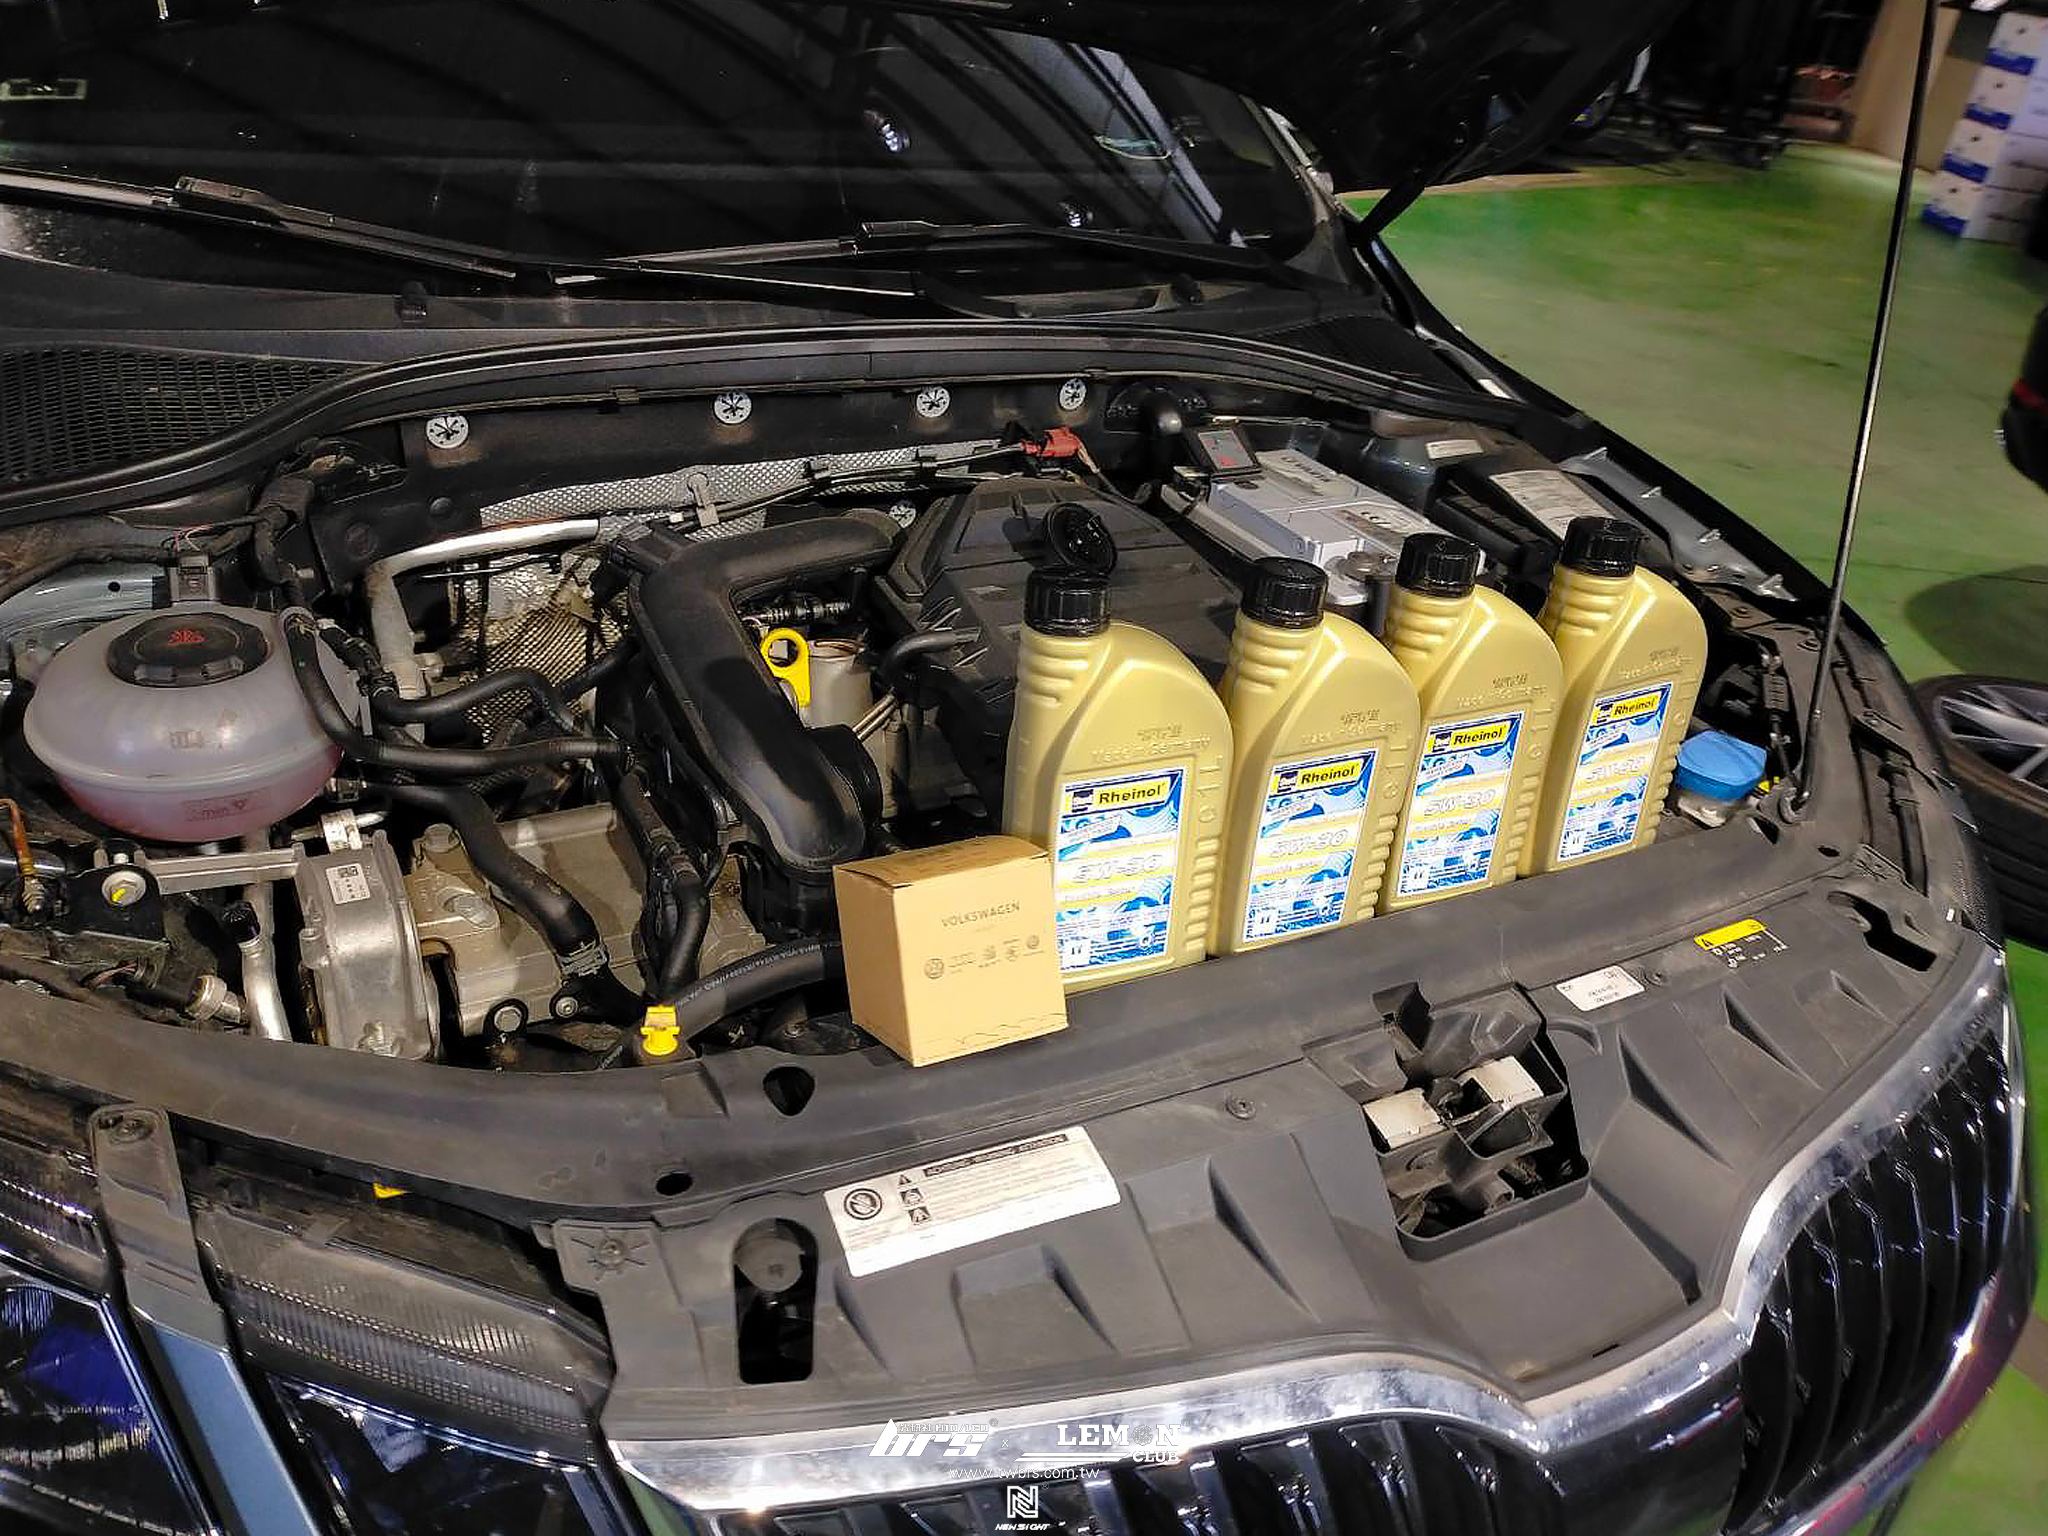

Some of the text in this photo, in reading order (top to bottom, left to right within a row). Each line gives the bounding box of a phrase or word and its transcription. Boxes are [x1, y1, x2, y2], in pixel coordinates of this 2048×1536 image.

[1614, 698, 1655, 715] Rheinol
[1453, 728, 1503, 745] Rheinol
[1301, 766, 1355, 785] Rheinol
[1098, 785, 1162, 804] Rheinol
[941, 900, 1020, 927] VOLKSWAGEN
